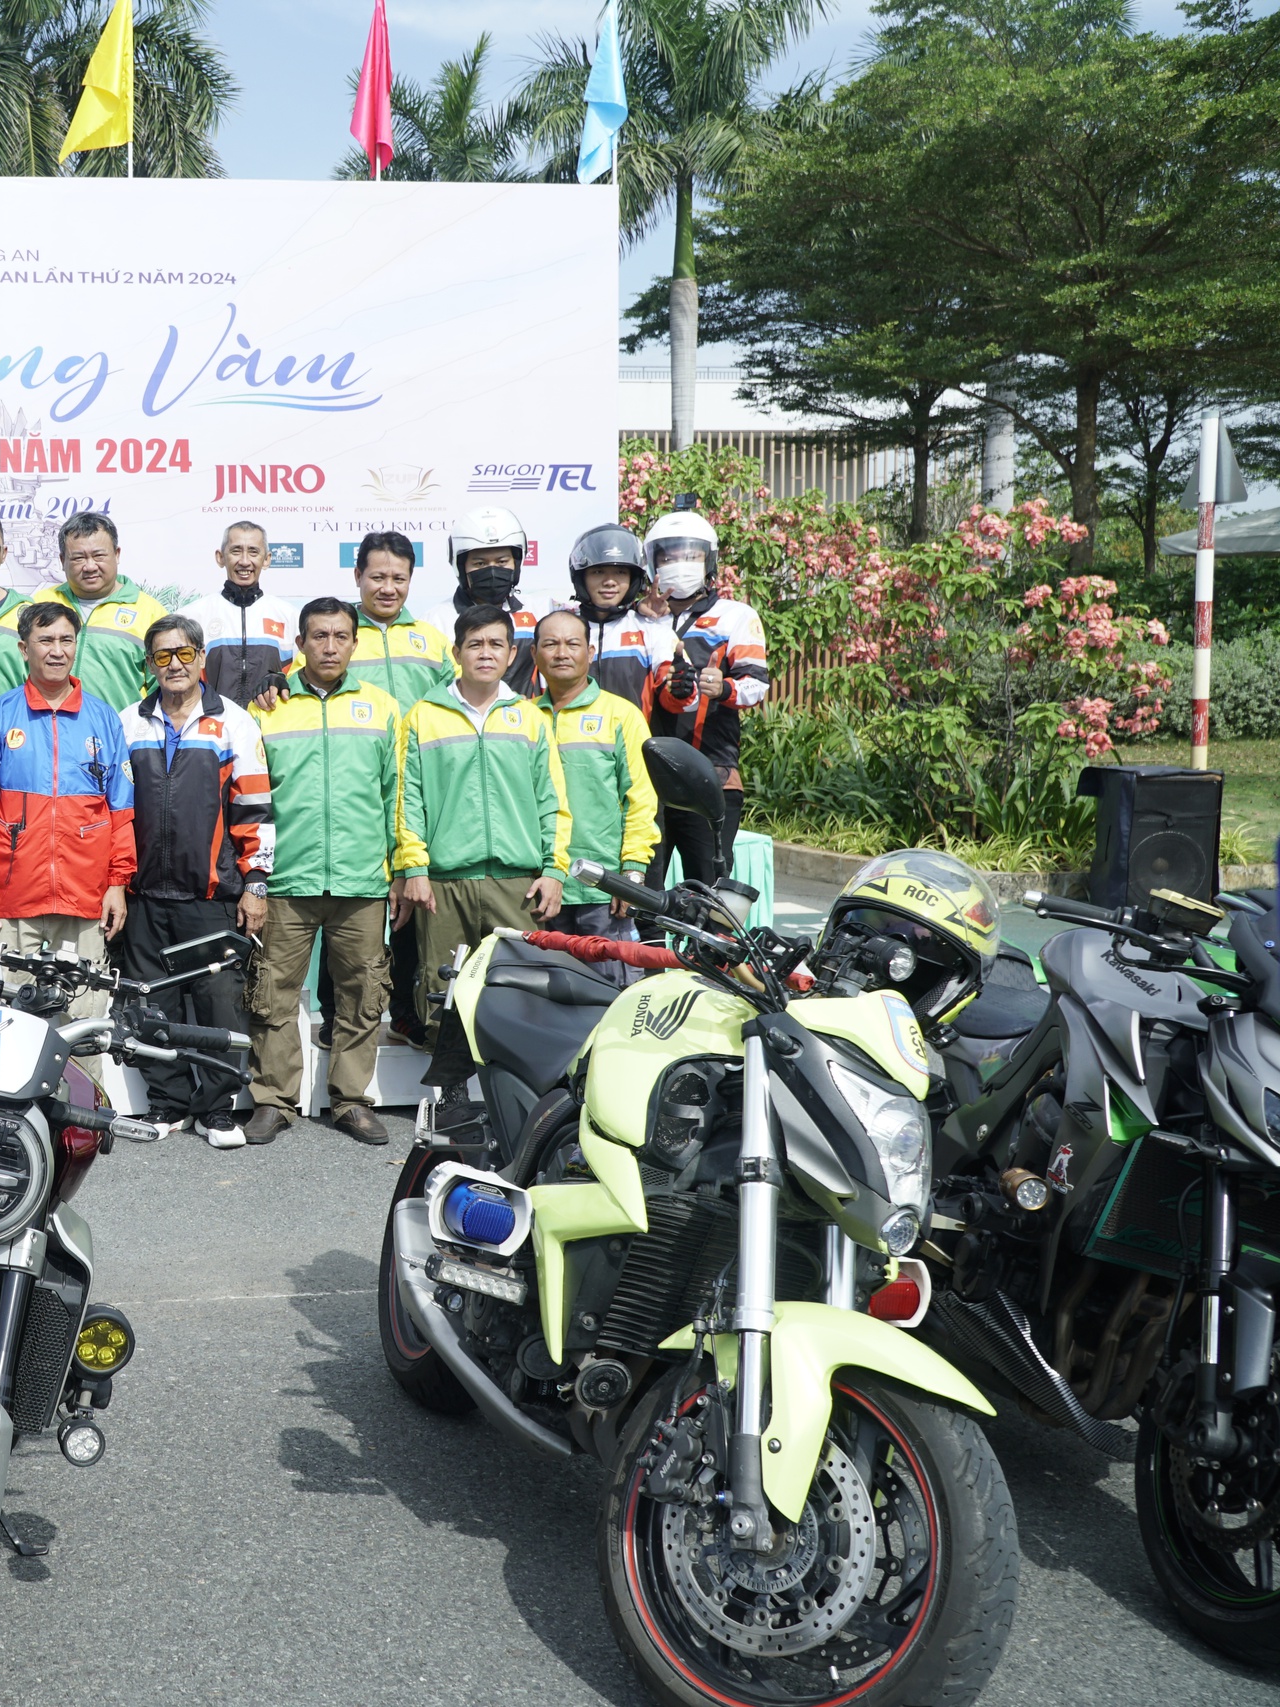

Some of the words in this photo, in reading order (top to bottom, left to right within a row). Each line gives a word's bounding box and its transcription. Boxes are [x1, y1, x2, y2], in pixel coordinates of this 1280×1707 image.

[11, 249, 40, 262] AN
[0, 271, 29, 284] AN
[33, 266, 73, 284] LẦN
[77, 268, 121, 284] THỨ
[123, 272, 134, 284] 2
[138, 268, 184, 284] NĂM
[189, 272, 237, 285] 2024
[141, 302, 373, 417] Vàm
[0, 433, 81, 474] NĂM
[95, 437, 193, 474] 2024
[210, 464, 325, 503] JINRO
[472, 464, 545, 476] SAIGON
[546, 464, 597, 491] TEL
[44, 496, 112, 519] 2024
[239, 506, 270, 514] DRINK,
[309, 520, 339, 532] TÀI
[391, 521, 422, 531] KIM
[903, 884, 939, 907] ROC
[630, 994, 651, 1037] HONDA
